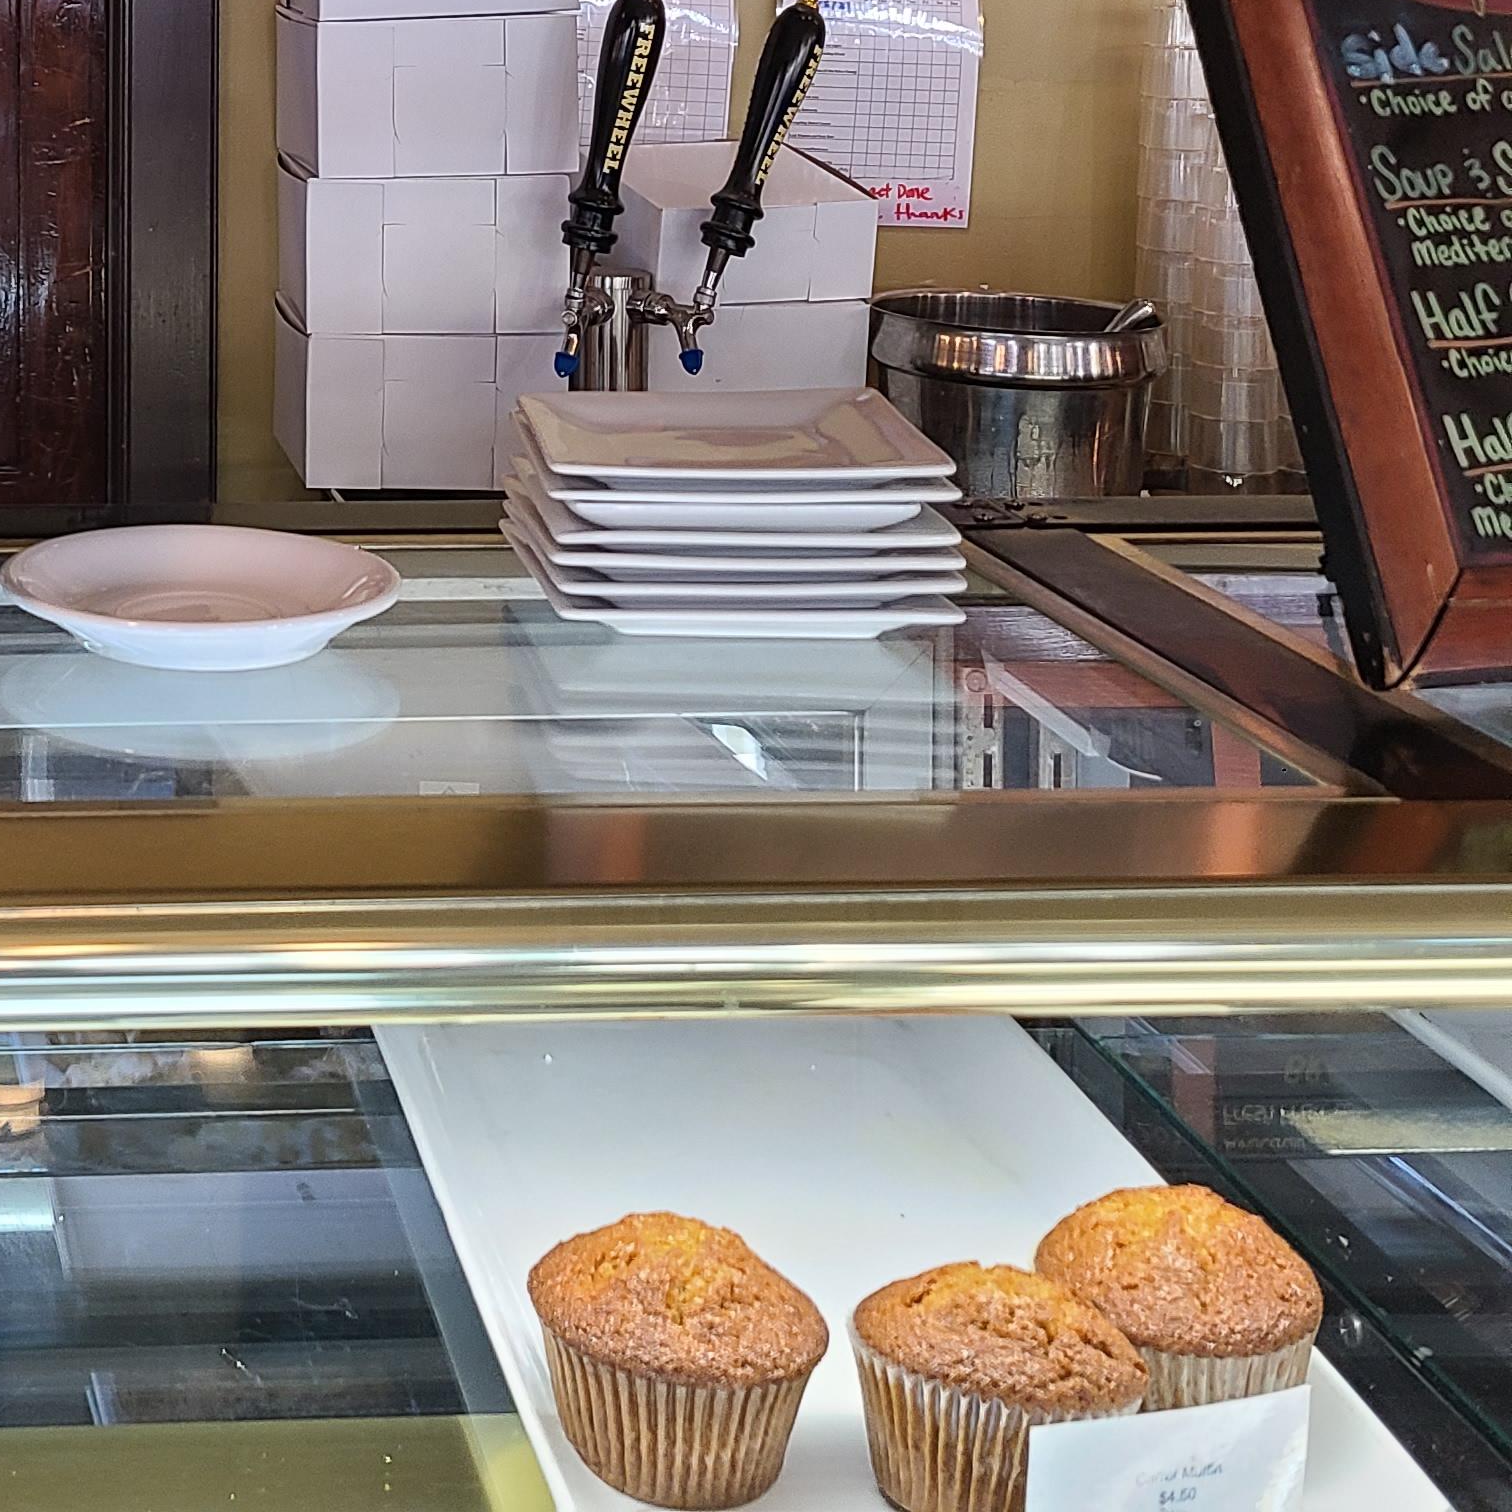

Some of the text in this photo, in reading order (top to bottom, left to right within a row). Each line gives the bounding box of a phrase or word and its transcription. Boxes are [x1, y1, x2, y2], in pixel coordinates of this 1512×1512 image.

[603, 24, 655, 174] FREEWHEEL
[1466, 79, 1493, 111] of
[1411, 282, 1500, 339] Half
